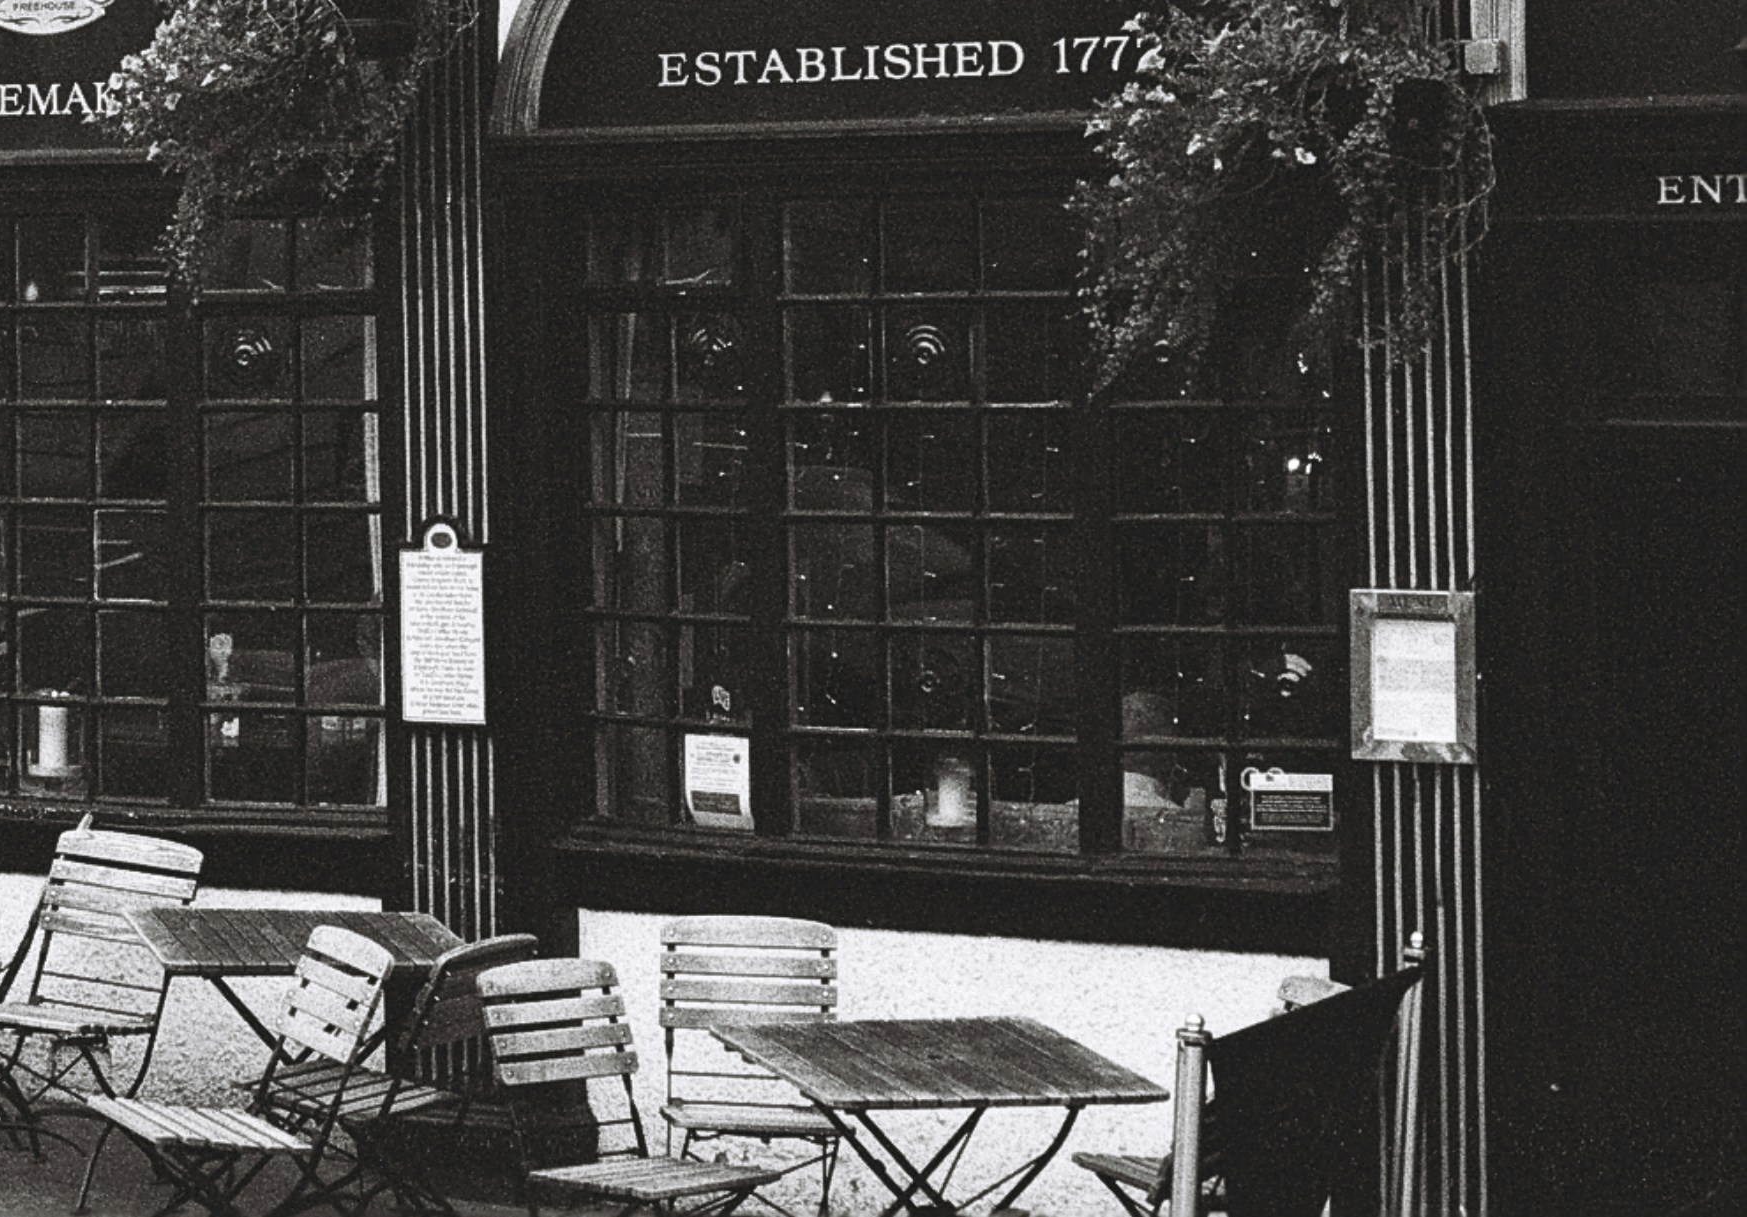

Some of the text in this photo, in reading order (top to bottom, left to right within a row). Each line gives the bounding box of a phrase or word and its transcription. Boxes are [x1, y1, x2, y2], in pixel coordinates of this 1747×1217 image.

[12, 1, 75, 12] FREEHOUSE
[658, 41, 1024, 87] ESTABLISHED
[1657, 175, 1747, 205] ENT
